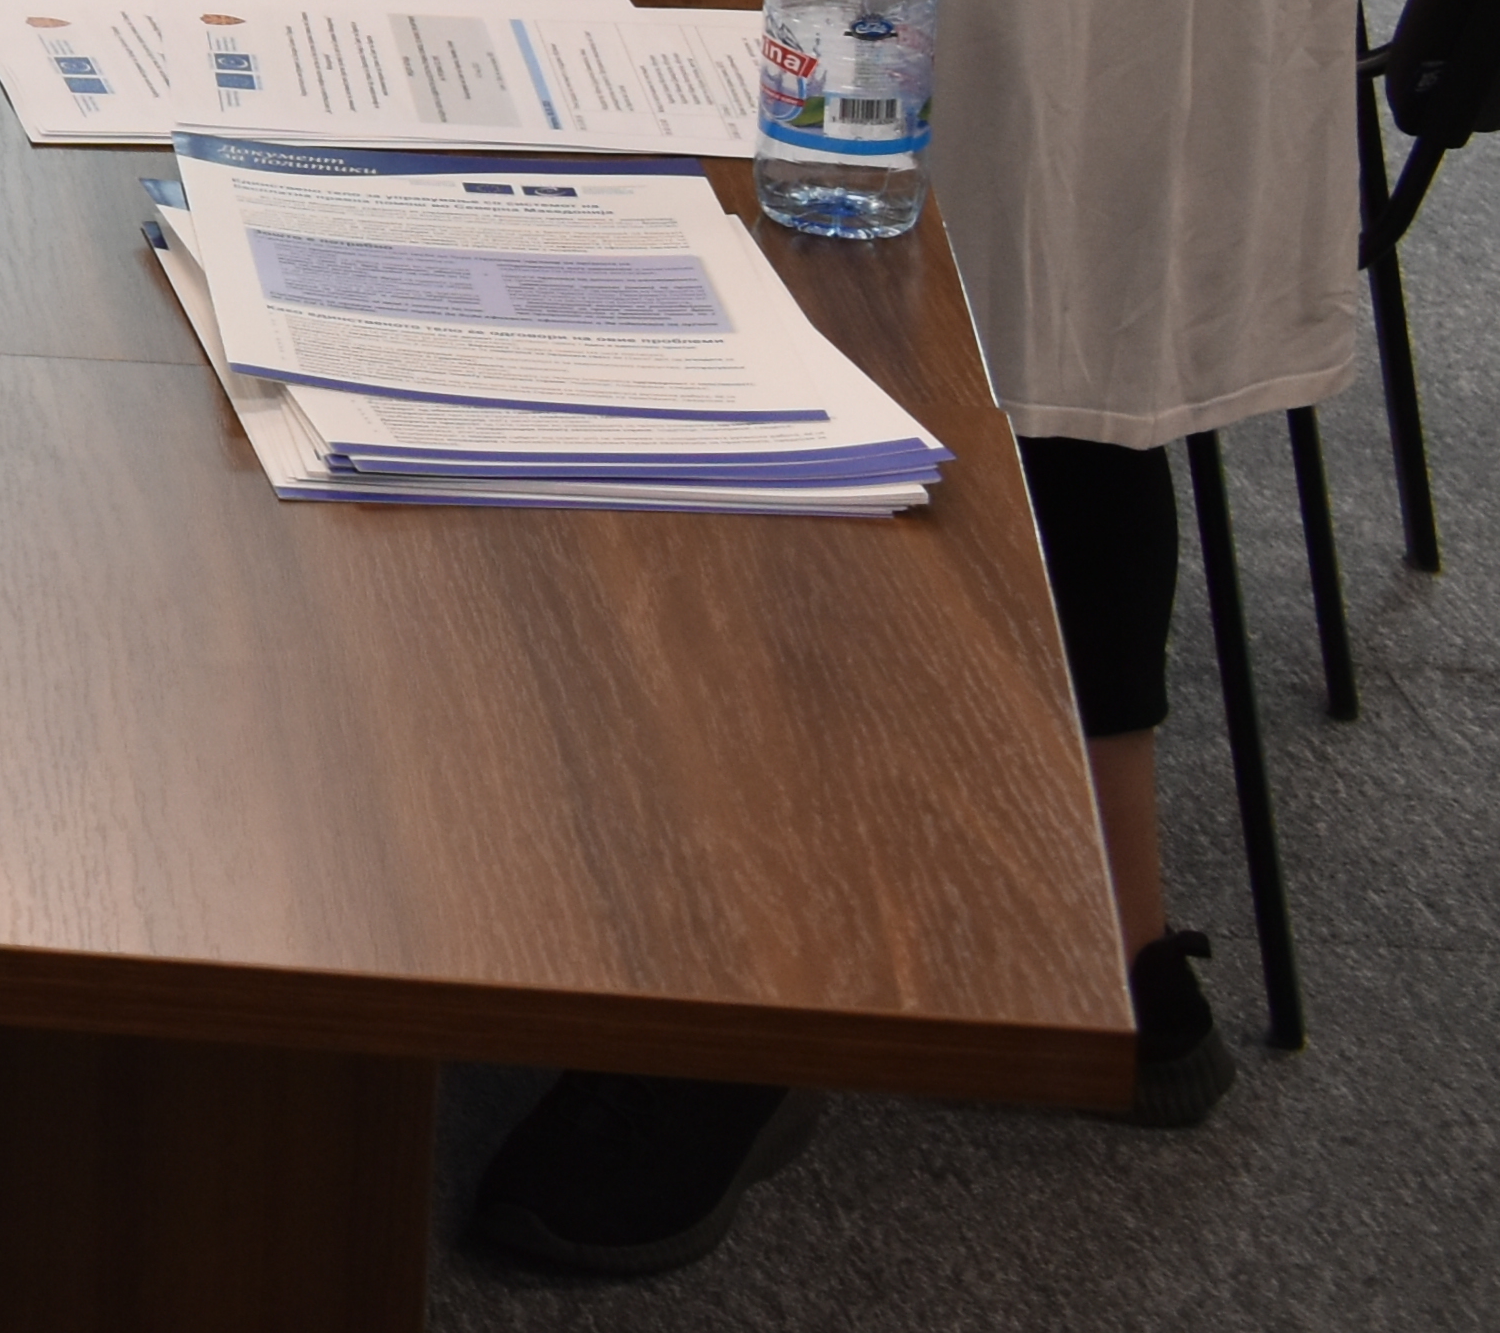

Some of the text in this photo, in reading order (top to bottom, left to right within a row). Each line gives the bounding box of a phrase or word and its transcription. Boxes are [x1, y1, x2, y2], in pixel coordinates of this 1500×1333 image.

[763, 41, 802, 73] ina
[217, 144, 345, 166] Документ
[220, 152, 378, 175] за политики
